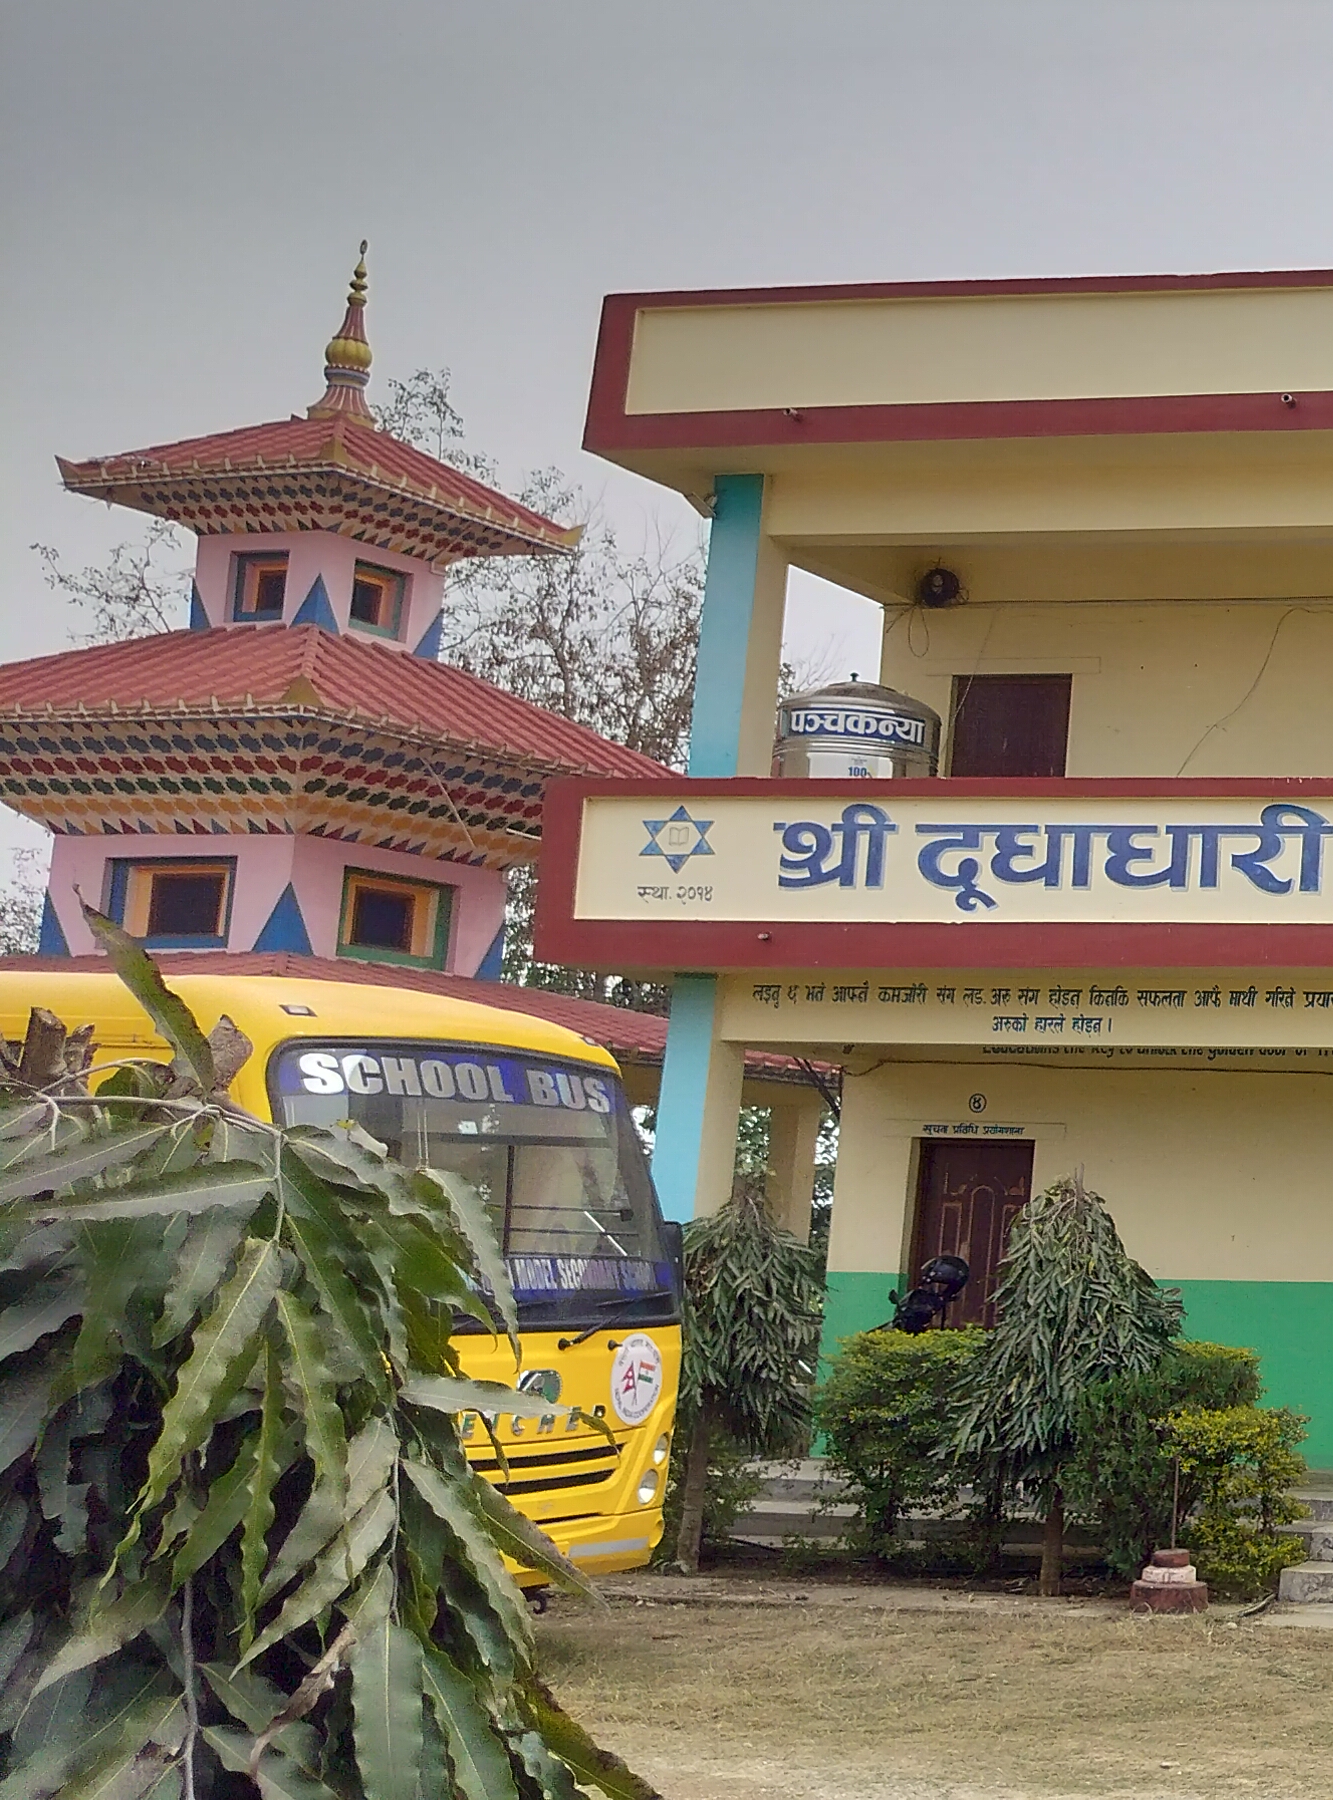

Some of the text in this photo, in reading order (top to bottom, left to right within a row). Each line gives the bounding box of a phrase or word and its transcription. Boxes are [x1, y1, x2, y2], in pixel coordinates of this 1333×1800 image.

[791, 709, 925, 744] पञ्चकन्या
[773, 803, 899, 889] श्री
[676, 886, 713, 904] २०१४
[1137, 990, 1187, 1009] सफलता
[300, 1053, 610, 1113] SCHOOL BUS
